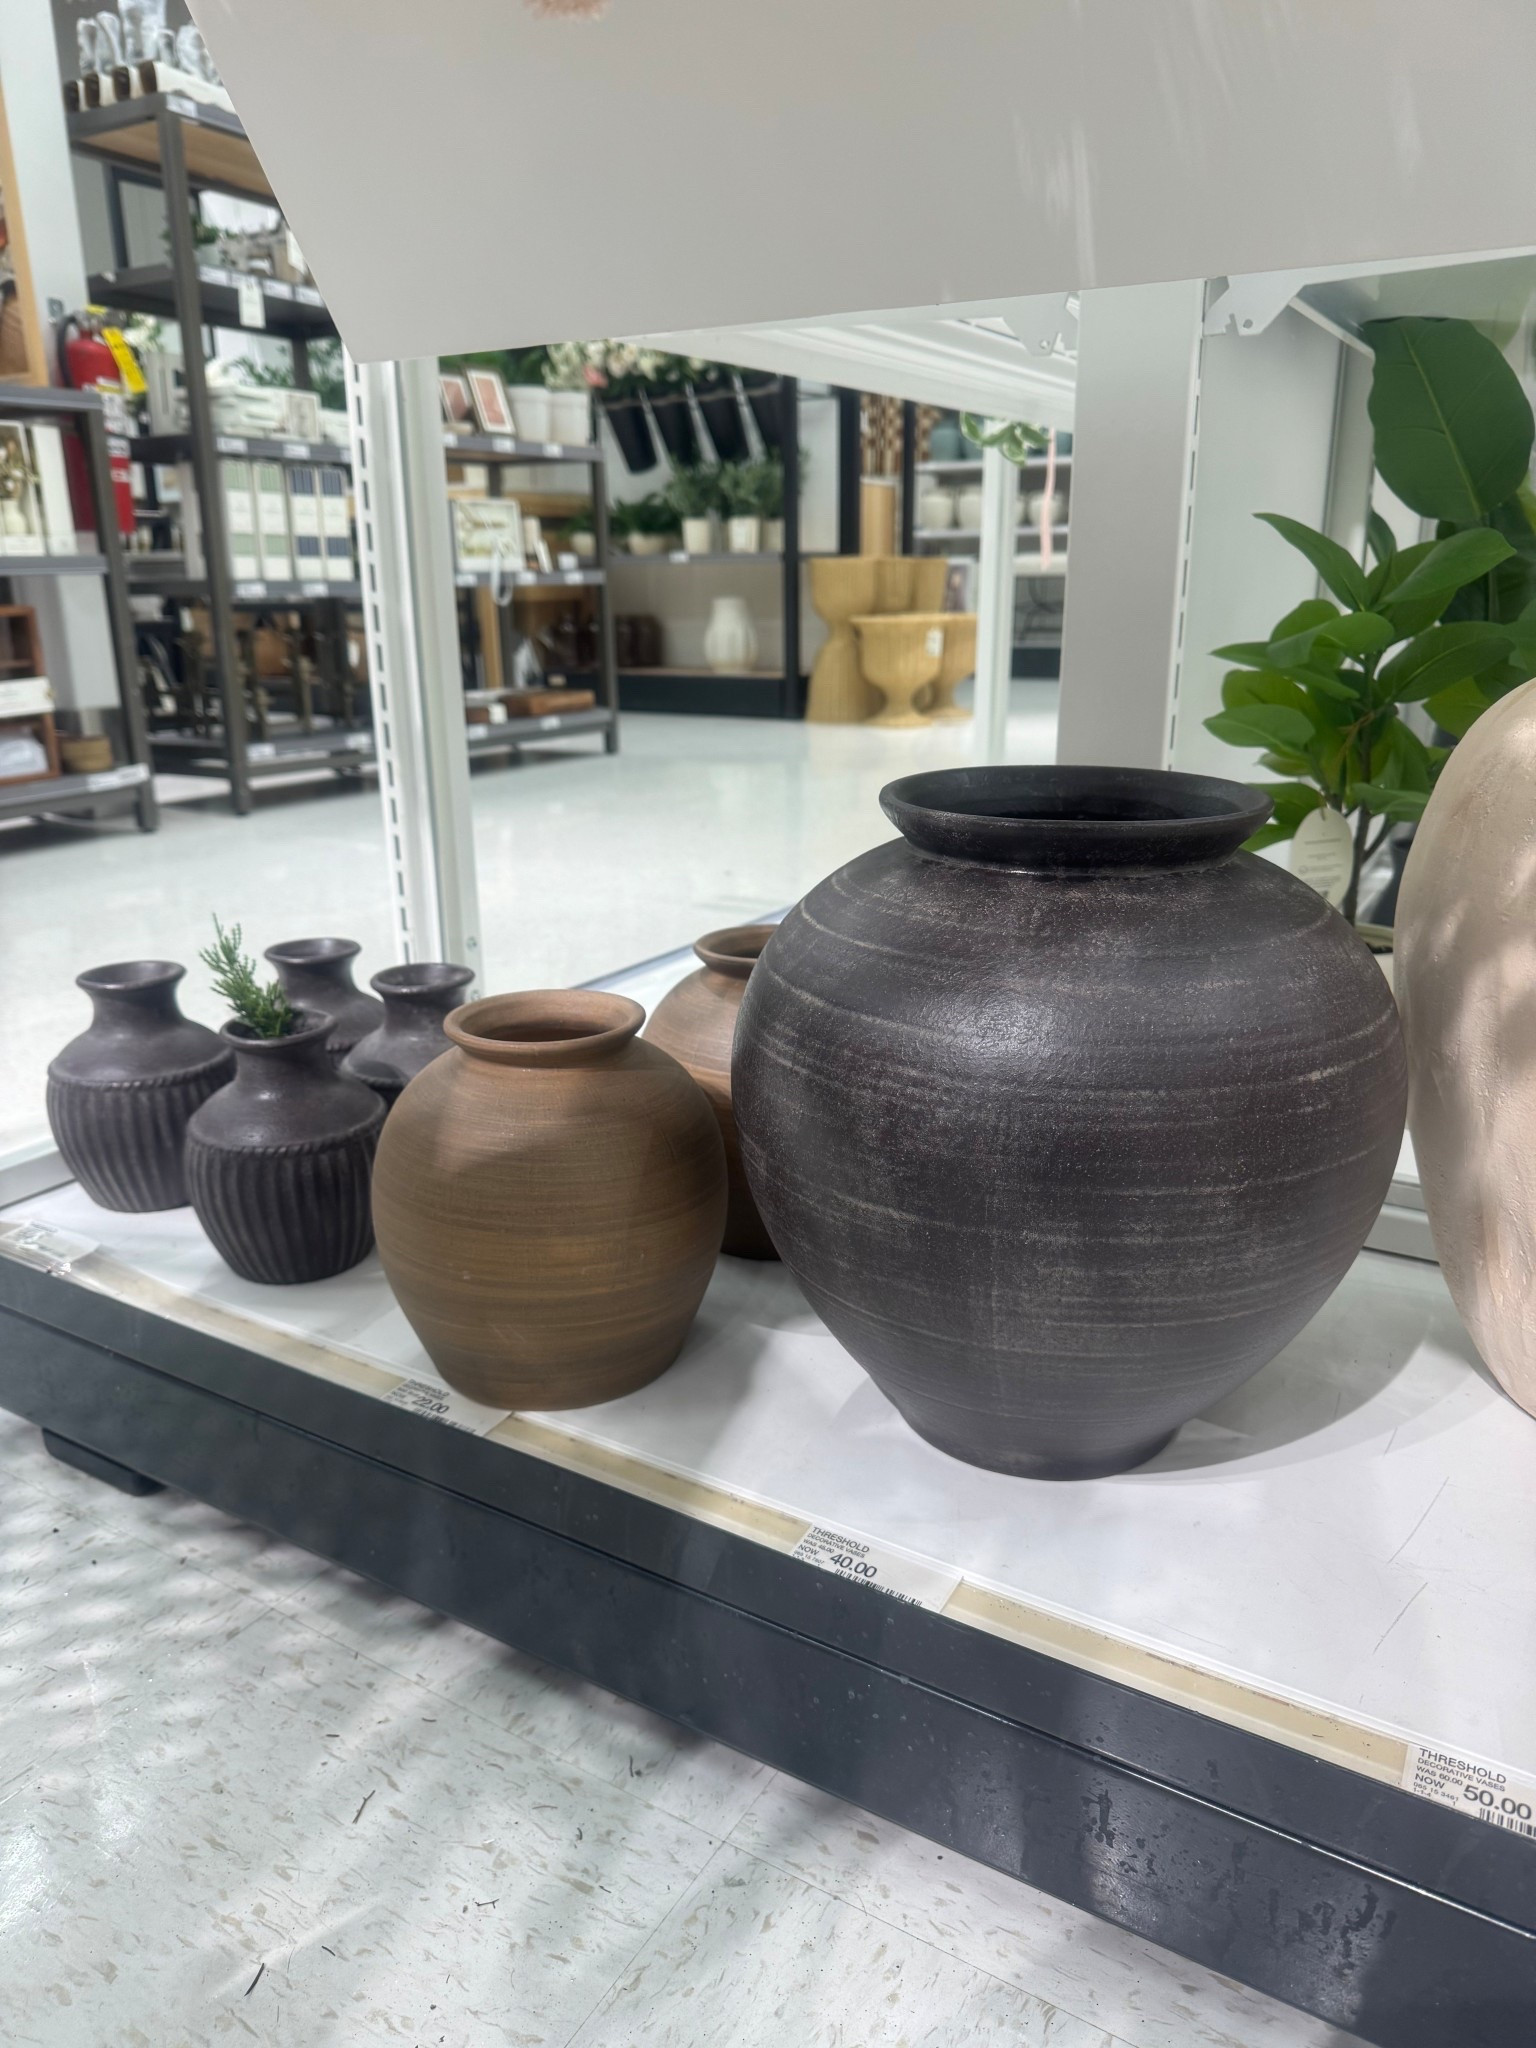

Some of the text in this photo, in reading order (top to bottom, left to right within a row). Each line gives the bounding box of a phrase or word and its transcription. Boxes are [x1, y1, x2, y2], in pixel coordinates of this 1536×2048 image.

[411, 1396, 450, 1413] 22.00
[803, 1538, 817, 1547] WAS
[807, 1533, 866, 1559] DECORATIVE VASES
[813, 1526, 870, 1553] THRESHOLD
[798, 1544, 878, 1578] NOW 40.00
[1416, 1765, 1464, 1786] WAS 60.00
[1417, 1757, 1506, 1792] DECORATIVE VASES
[1419, 1747, 1507, 1784] THRESHOLD
[1414, 1773, 1532, 1820] NOW 50.00
